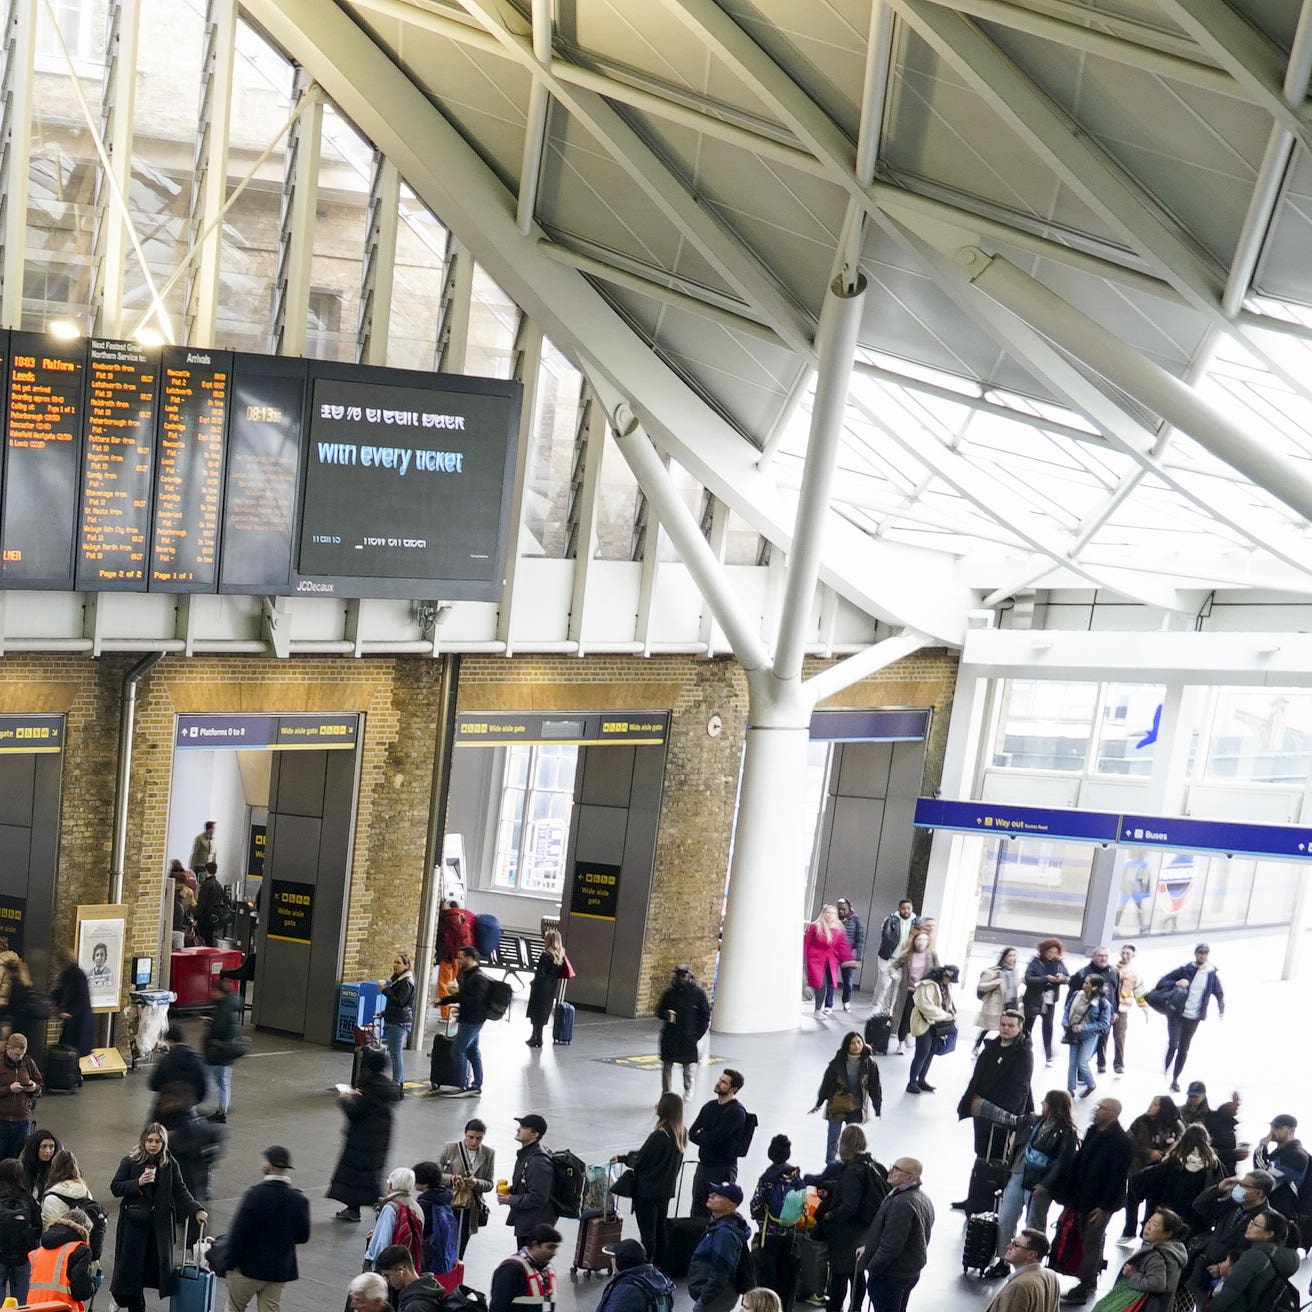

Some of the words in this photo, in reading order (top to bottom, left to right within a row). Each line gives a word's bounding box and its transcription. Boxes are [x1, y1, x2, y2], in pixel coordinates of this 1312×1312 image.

[186, 353, 211, 365] Arrivals
[361, 445, 412, 476] every
[297, 581, 335, 593] JCDecaux
[0, 730, 14, 740] gate
[199, 727, 227, 737] Platforms
[233, 728, 240, 736] to
[280, 727, 294, 735] Wide
[294, 727, 306, 735] aisle
[306, 727, 319, 736] gate
[995, 817, 1010, 829] Way
[1010, 819, 1024, 828] out
[1145, 830, 1168, 841] Buses
[582, 887, 595, 896] Wide
[278, 907, 291, 916] Wide
